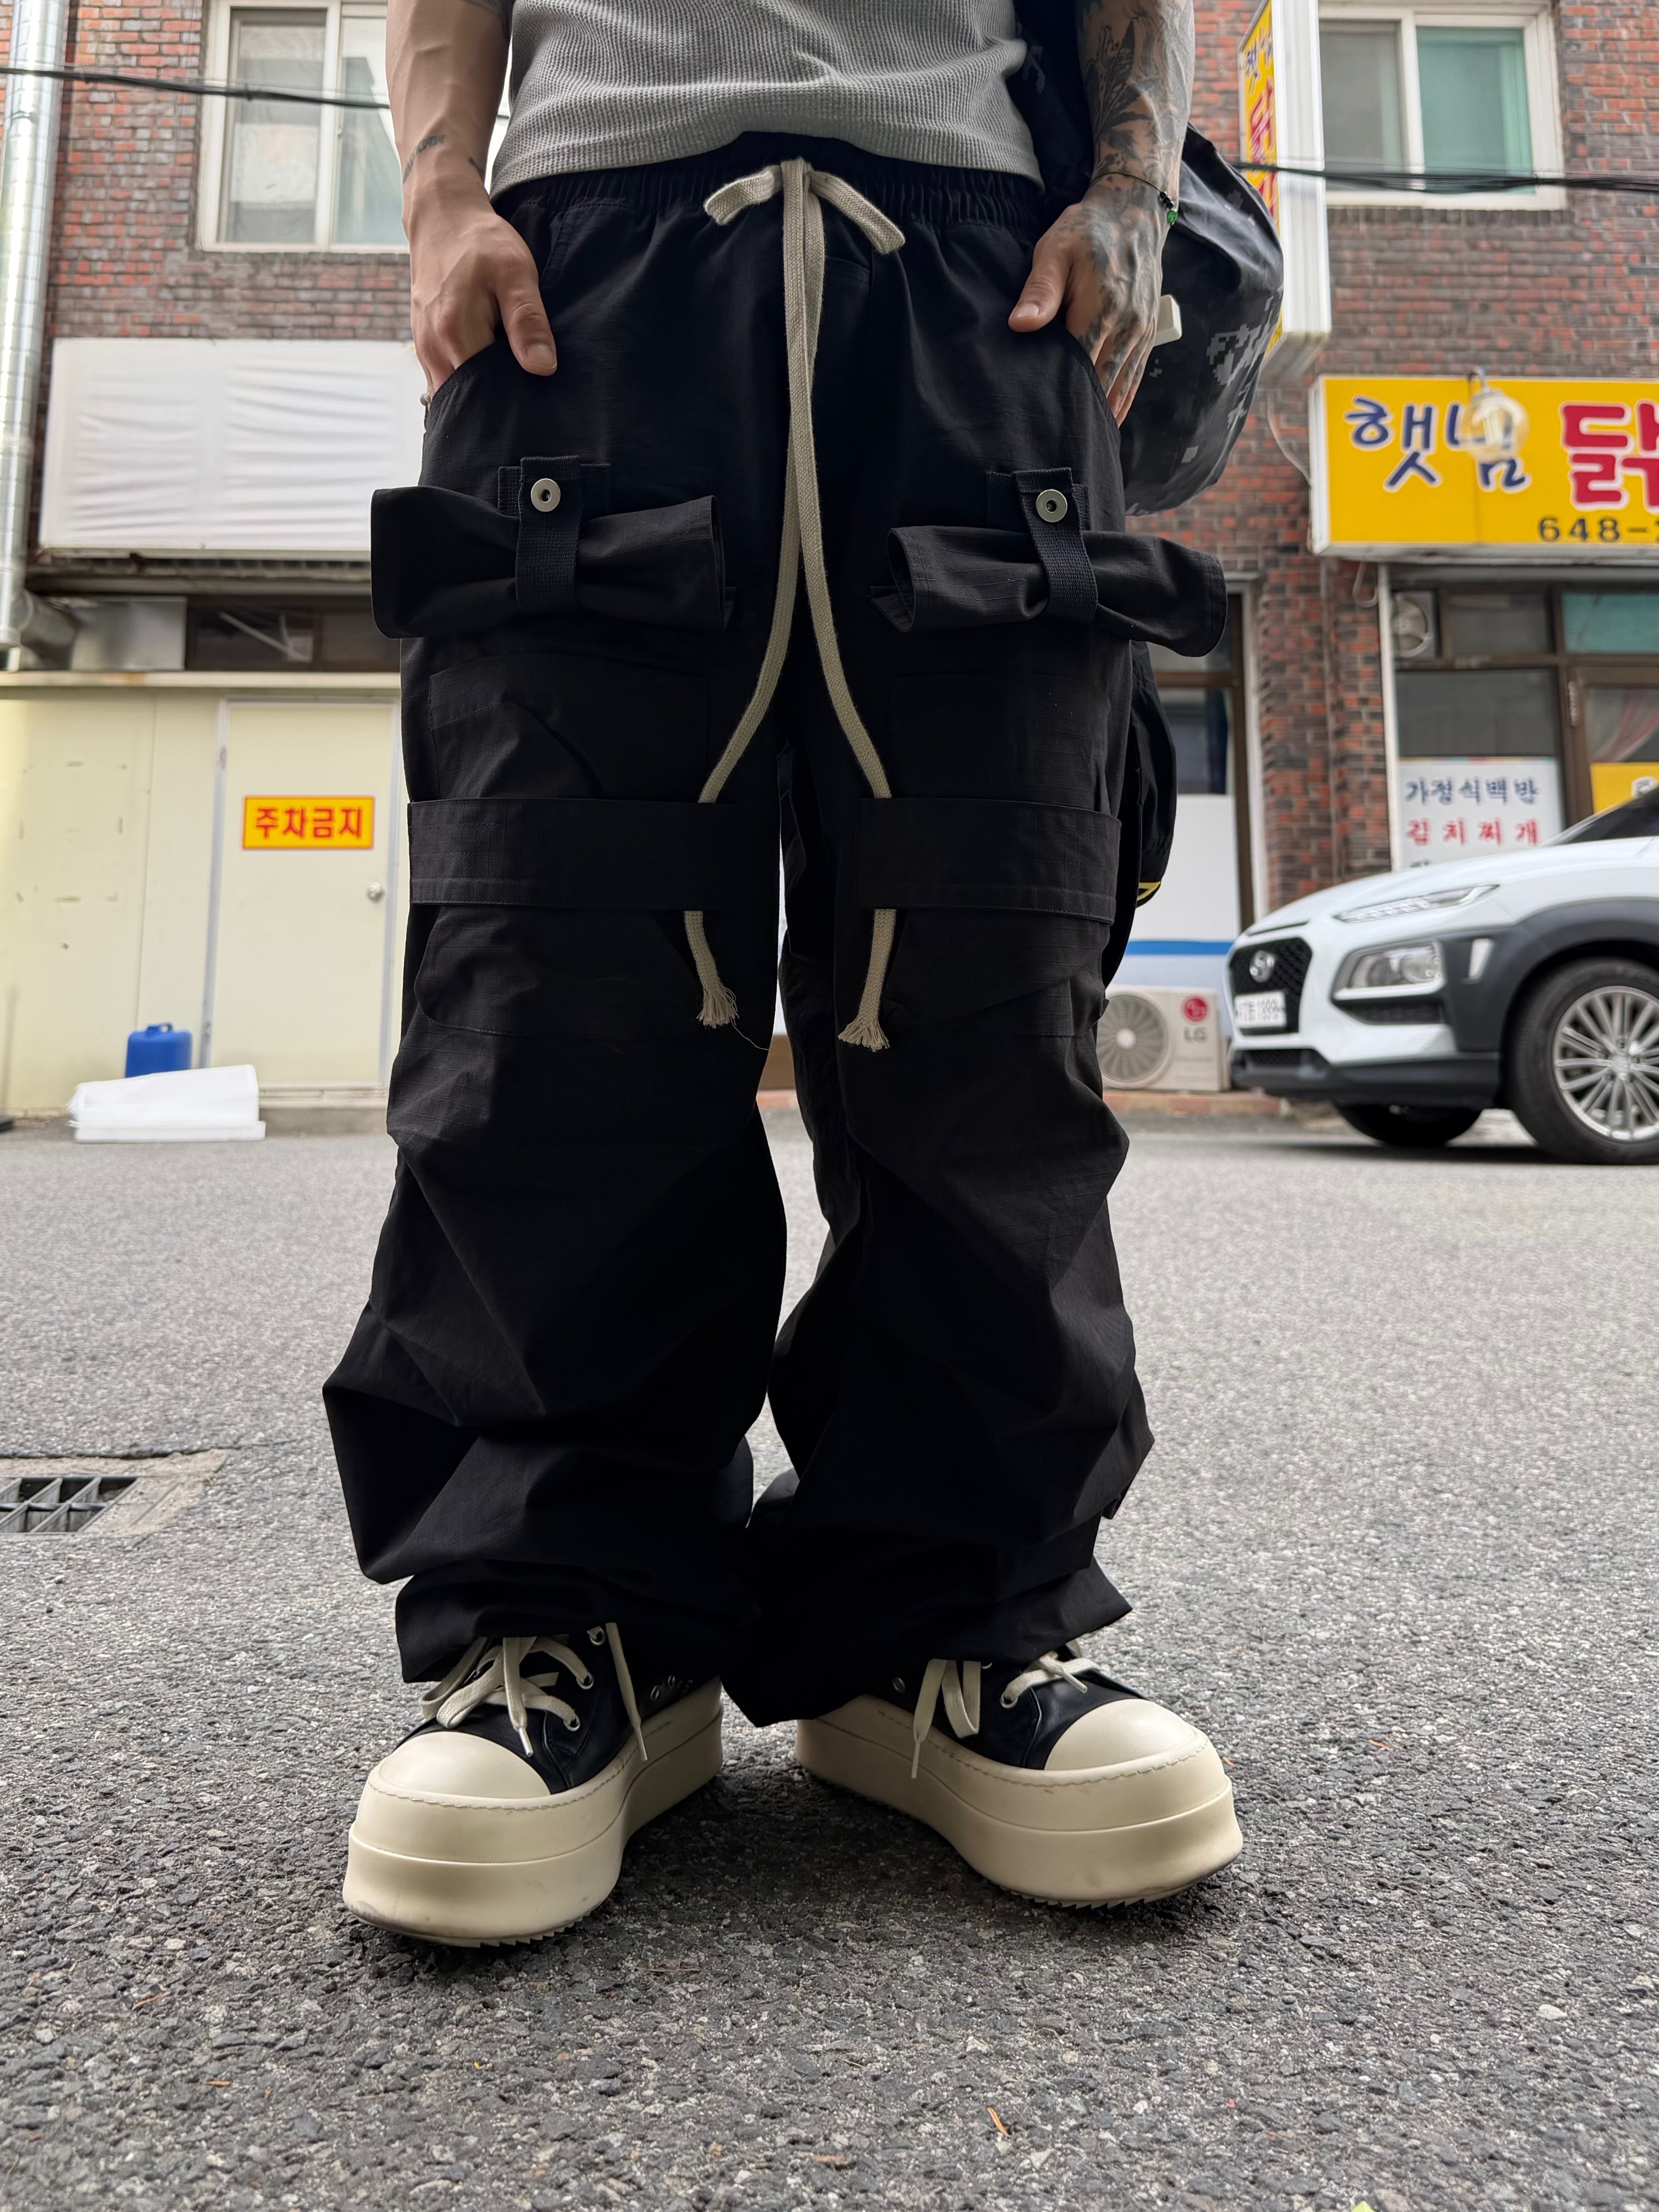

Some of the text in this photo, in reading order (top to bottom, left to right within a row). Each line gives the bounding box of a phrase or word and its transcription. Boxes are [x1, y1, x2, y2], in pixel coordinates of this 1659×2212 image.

[1538, 516, 1659, 541] 648-
[256, 806, 362, 838] 주차금지
[1407, 818, 1538, 846] 김치찌개
[1185, 1027, 1207, 1042] LG
